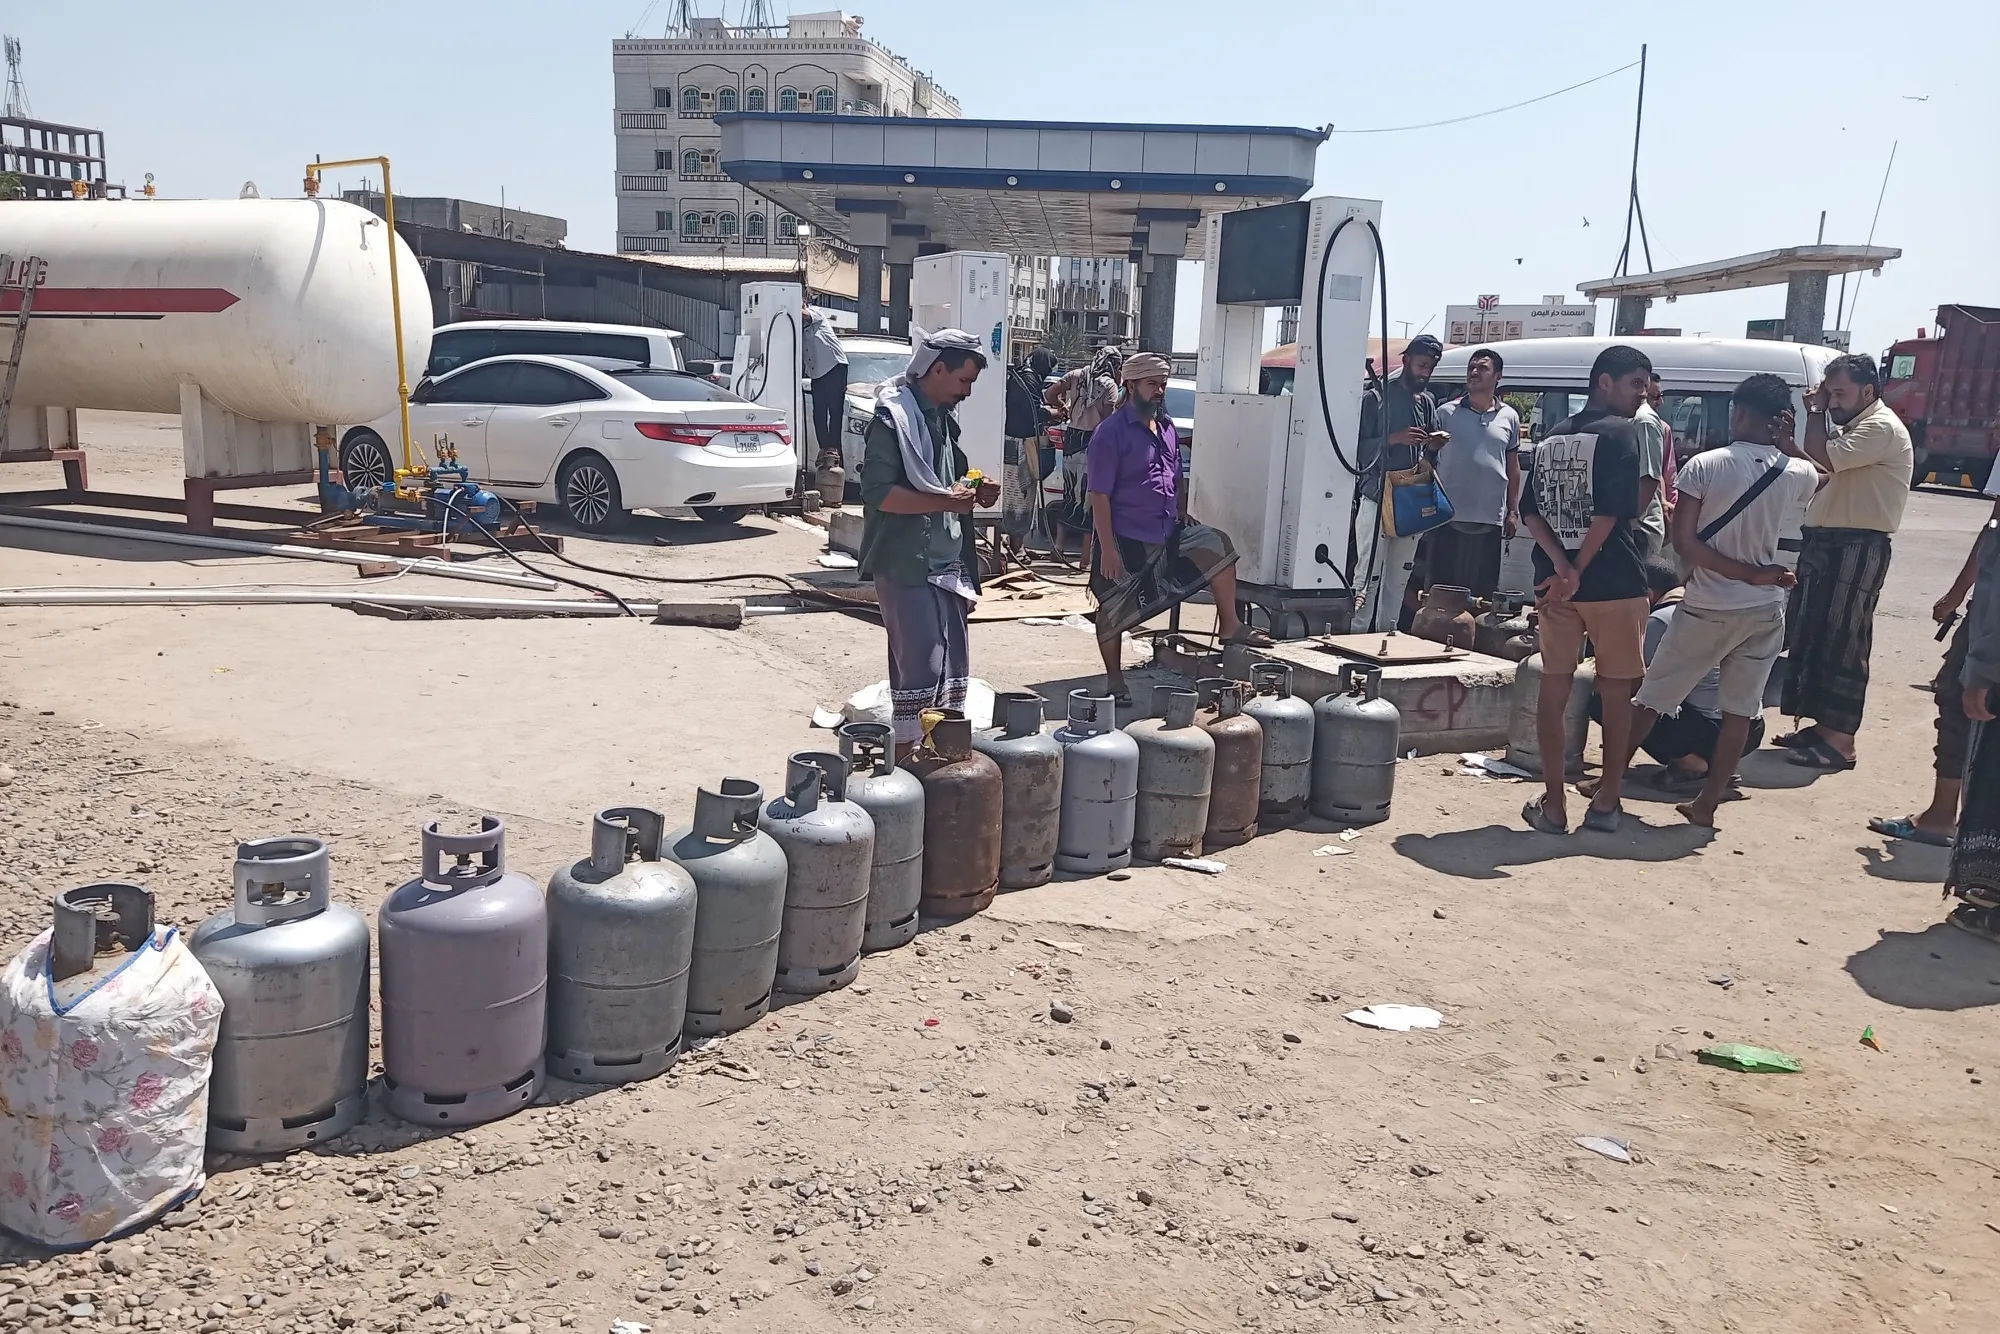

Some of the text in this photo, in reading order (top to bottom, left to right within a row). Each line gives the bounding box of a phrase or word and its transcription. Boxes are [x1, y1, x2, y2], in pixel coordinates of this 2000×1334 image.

[1531, 309, 1550, 318] اليمن
[1550, 309, 1560, 318] دار
[1560, 530, 1579, 538] York
